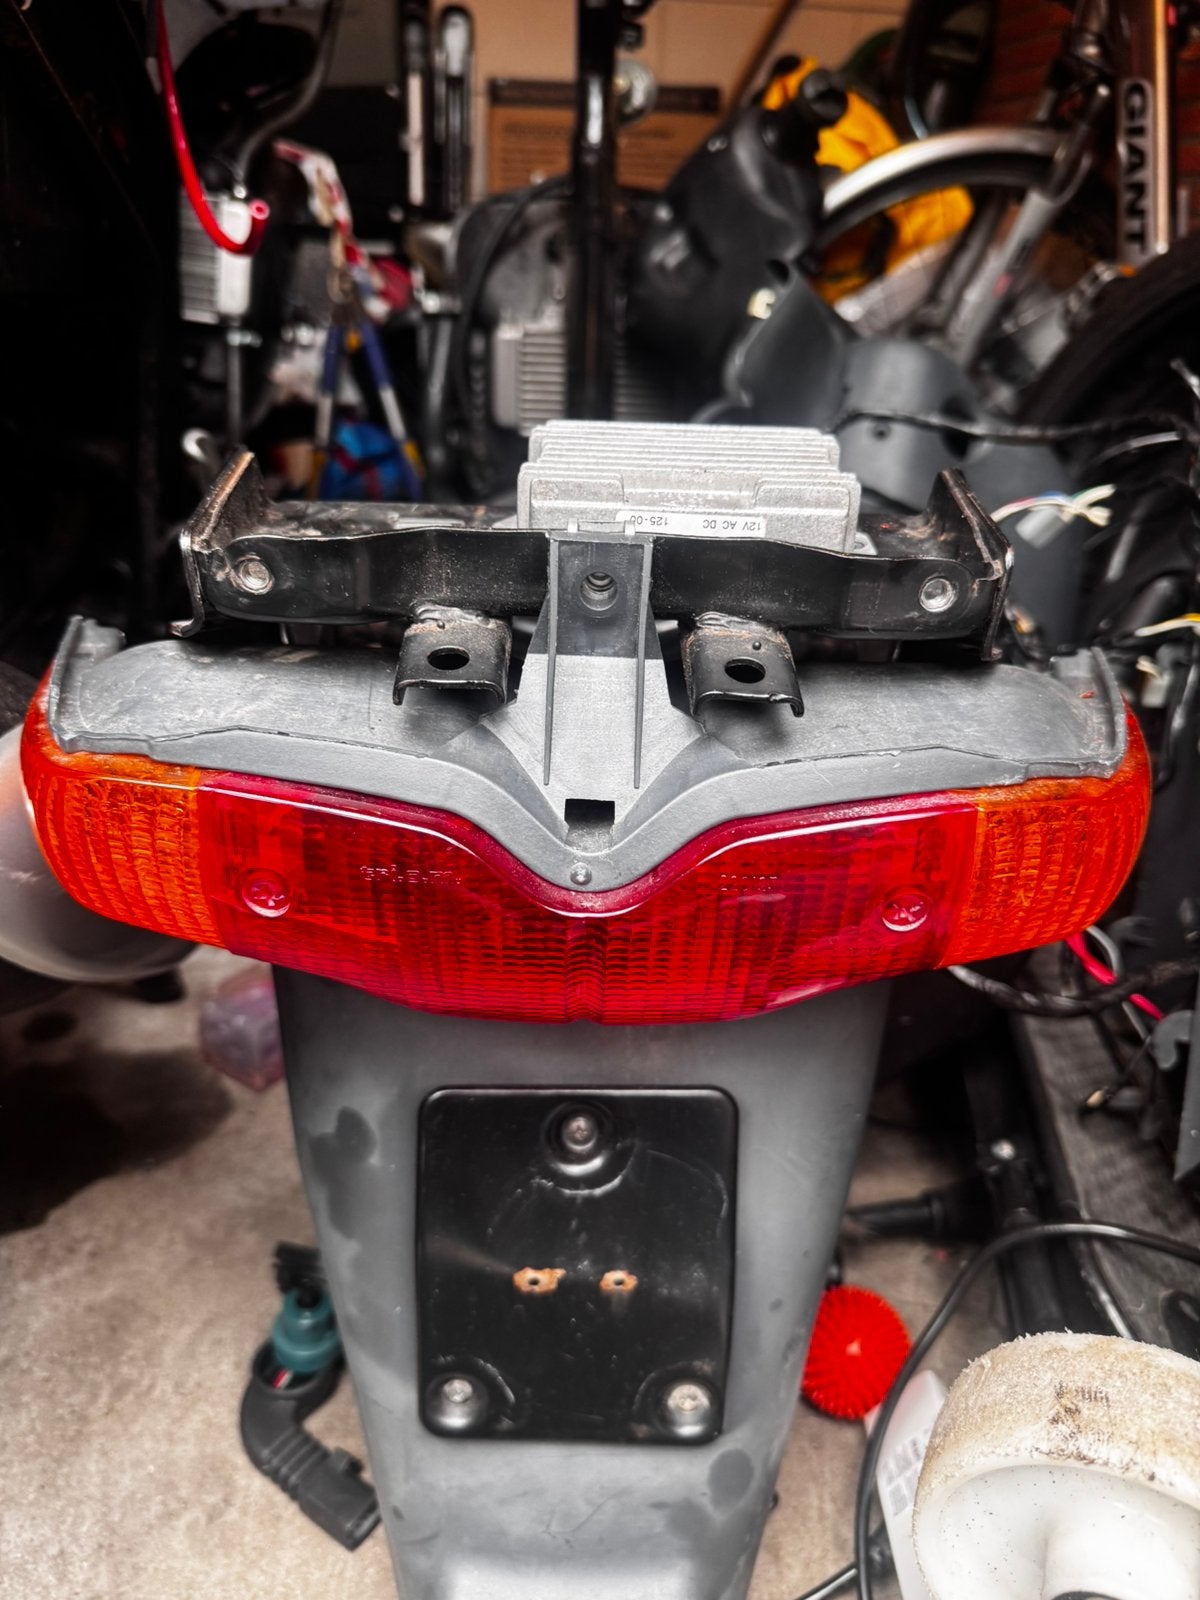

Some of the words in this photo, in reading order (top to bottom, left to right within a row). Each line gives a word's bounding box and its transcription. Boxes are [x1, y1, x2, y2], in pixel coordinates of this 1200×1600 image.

[1125, 82, 1146, 253] GIANT
[702, 519, 717, 529] DC
[722, 520, 738, 530] AC
[743, 521, 761, 531] 12V
